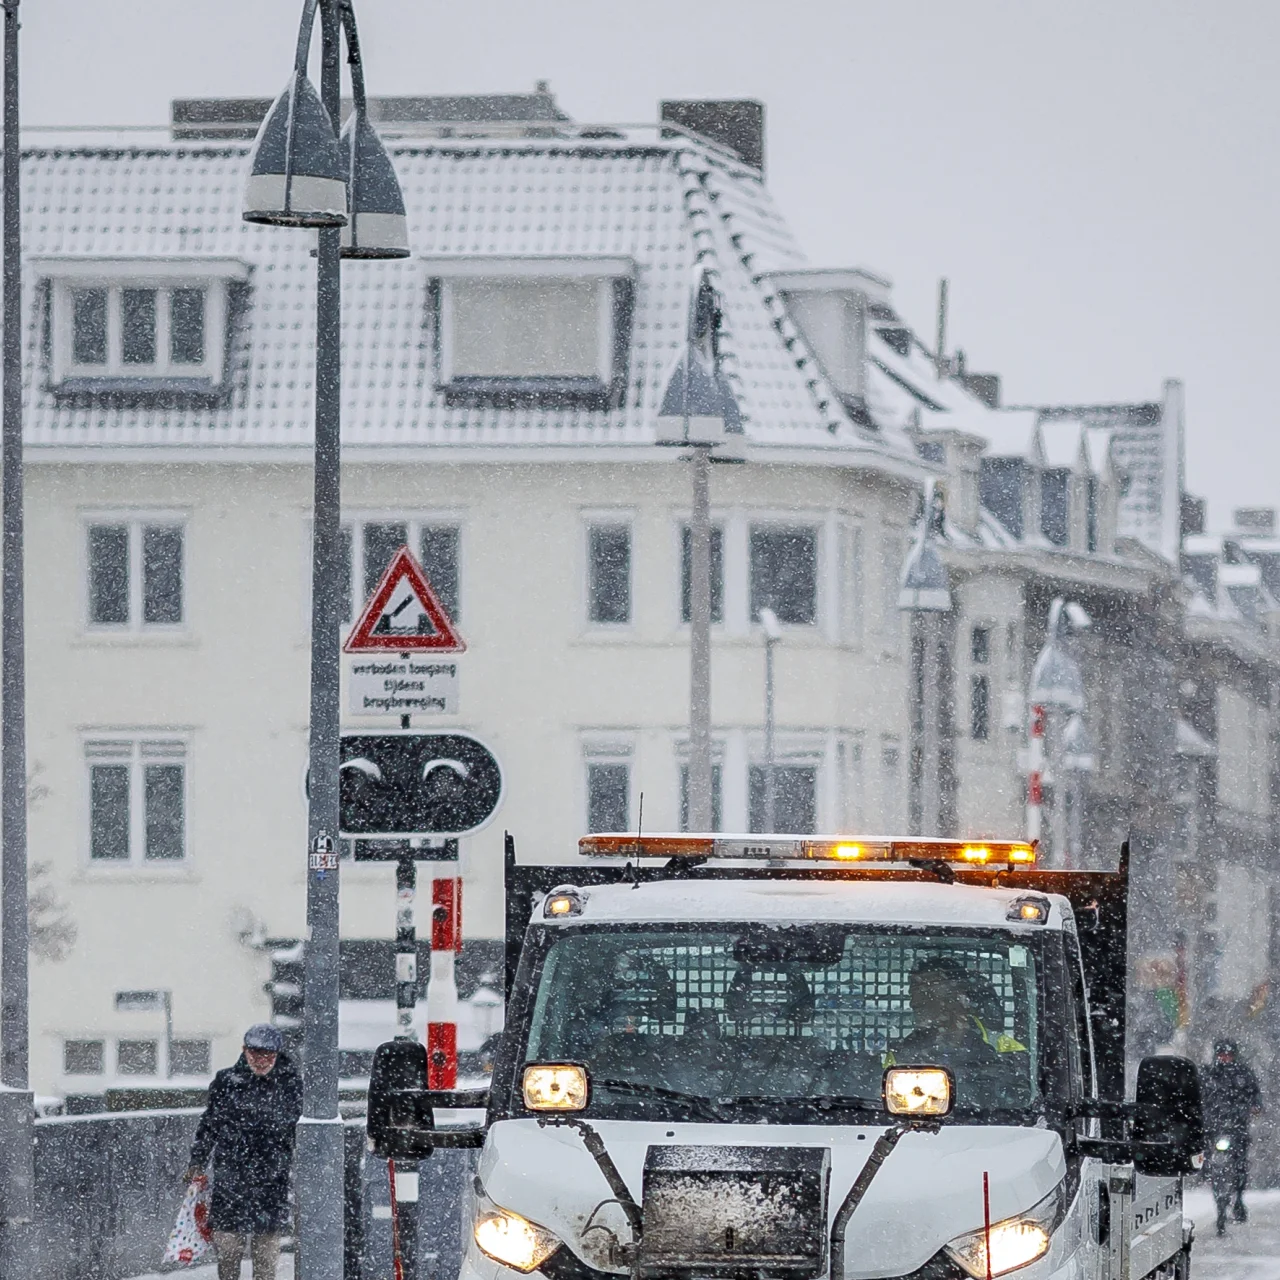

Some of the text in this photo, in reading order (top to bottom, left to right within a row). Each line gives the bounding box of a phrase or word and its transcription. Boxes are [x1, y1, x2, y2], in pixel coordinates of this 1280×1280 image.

[353, 663, 456, 677] verboden toegang
[383, 680, 424, 694] tijdens
[363, 696, 446, 711] brugbeweging
